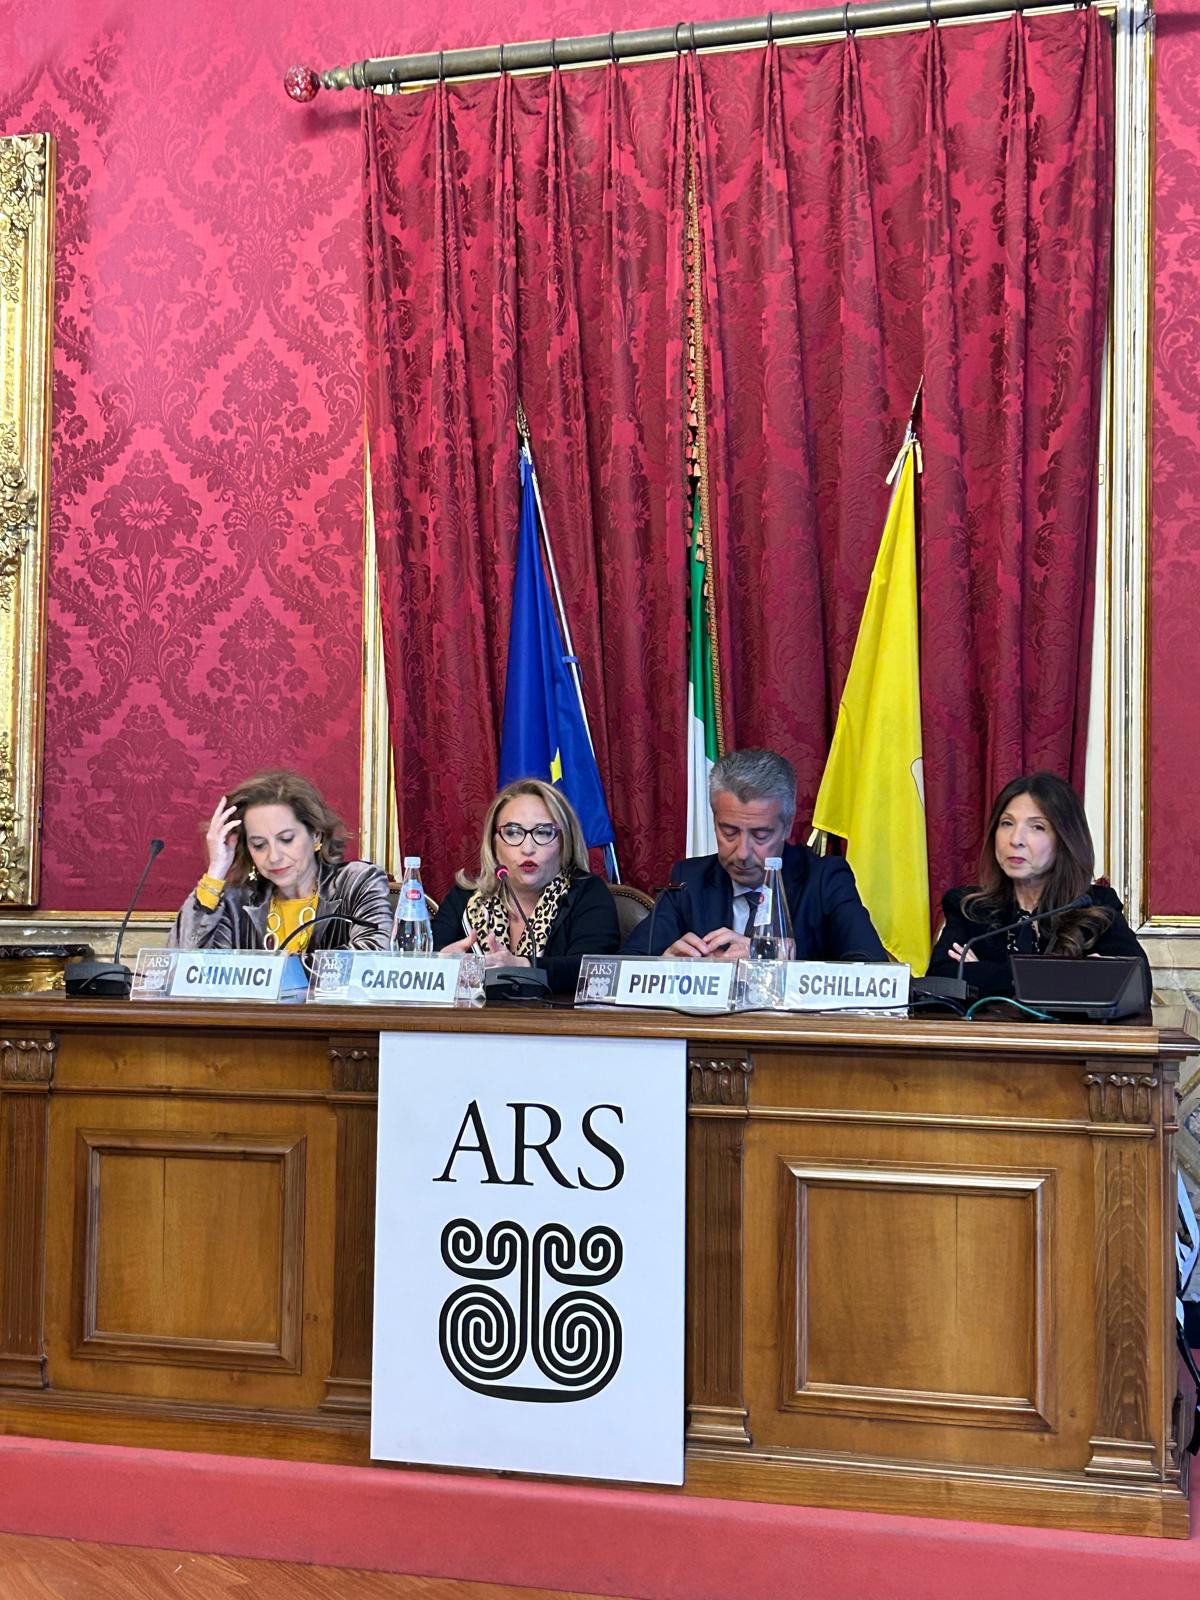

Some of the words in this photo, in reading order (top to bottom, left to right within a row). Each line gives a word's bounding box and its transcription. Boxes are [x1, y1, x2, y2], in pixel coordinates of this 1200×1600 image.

[147, 956, 170, 968] ARS
[590, 964, 613, 975] ARS
[186, 965, 273, 987] CHINNICI
[361, 969, 446, 991] CARONIA
[629, 973, 721, 996] PIPITONE
[798, 974, 897, 999] SCHILLACI
[432, 1099, 625, 1191] ARS
